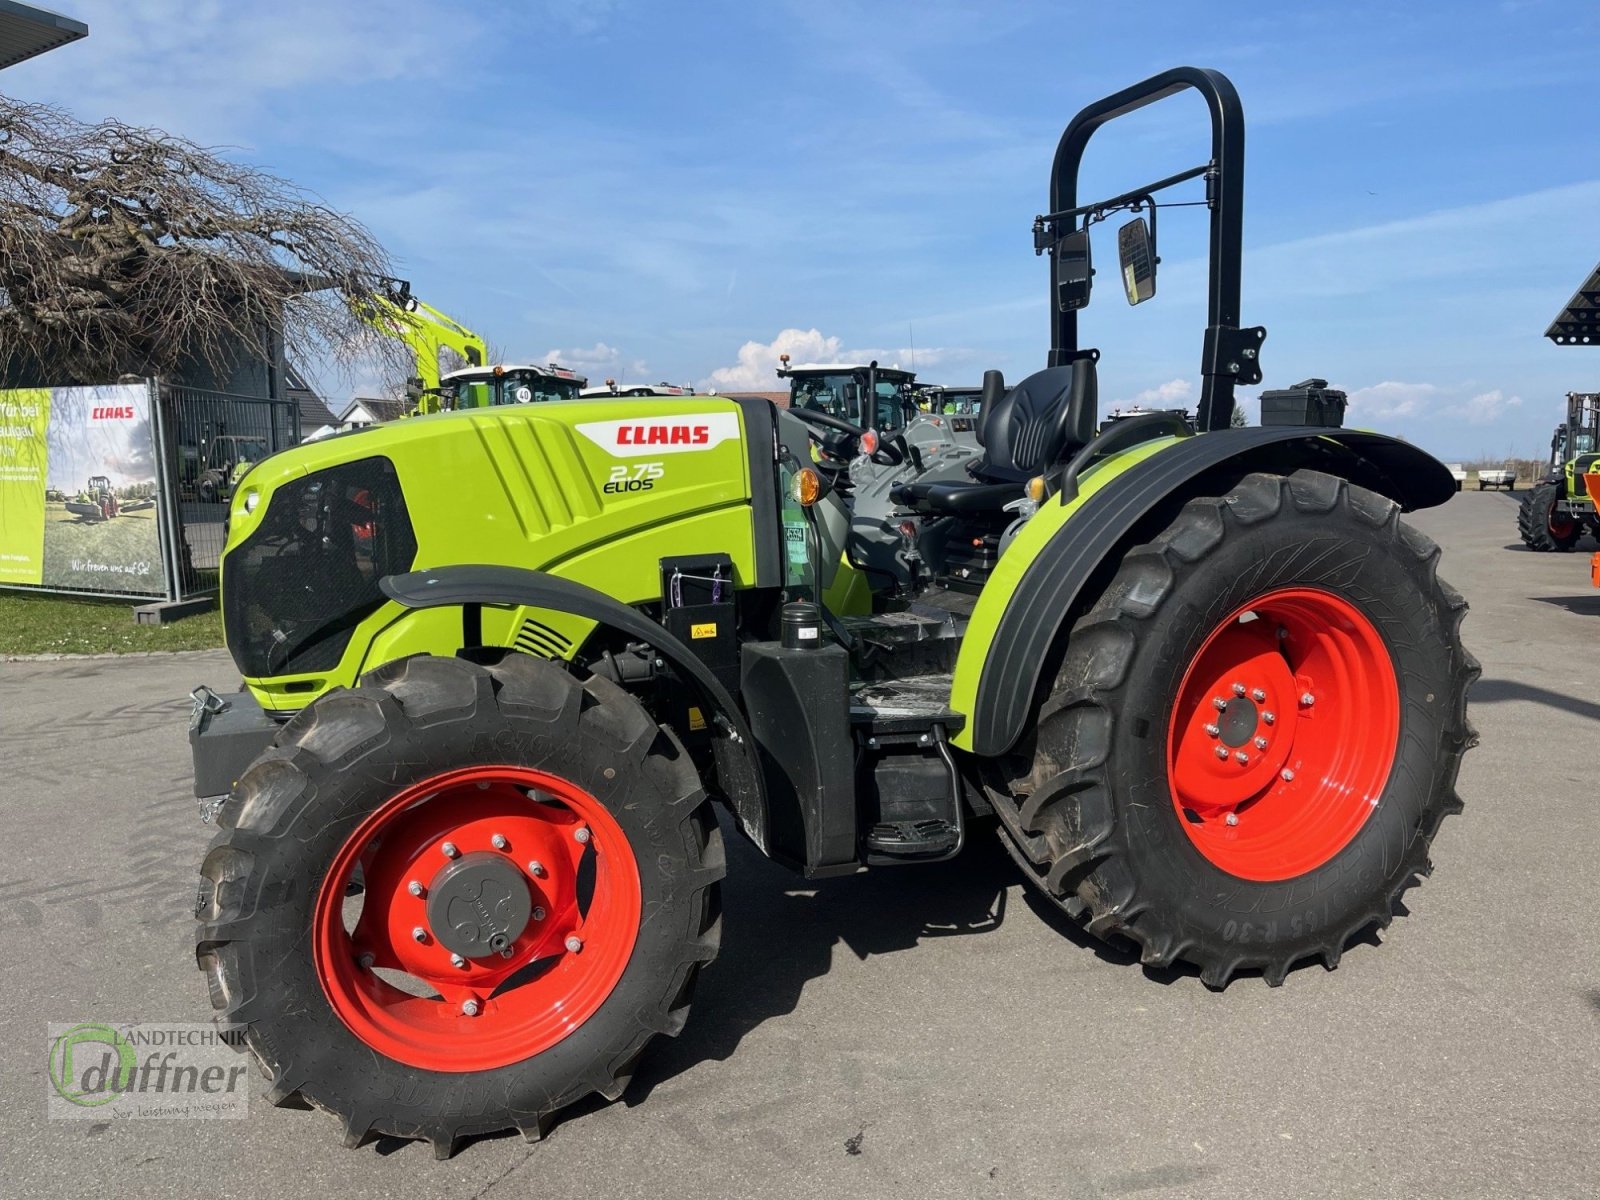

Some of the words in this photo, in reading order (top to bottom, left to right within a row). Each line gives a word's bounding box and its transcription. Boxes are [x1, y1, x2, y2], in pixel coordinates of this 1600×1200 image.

[519, 390, 529, 400] 40
[92, 406, 134, 420] CLAAS
[616, 426, 709, 445] CLAAS
[610, 462, 665, 482] 2.75
[603, 478, 654, 494] ELIOS
[72, 559, 86, 572] Wir
[87, 559, 109, 573] freuen
[110, 564, 123, 574] uns
